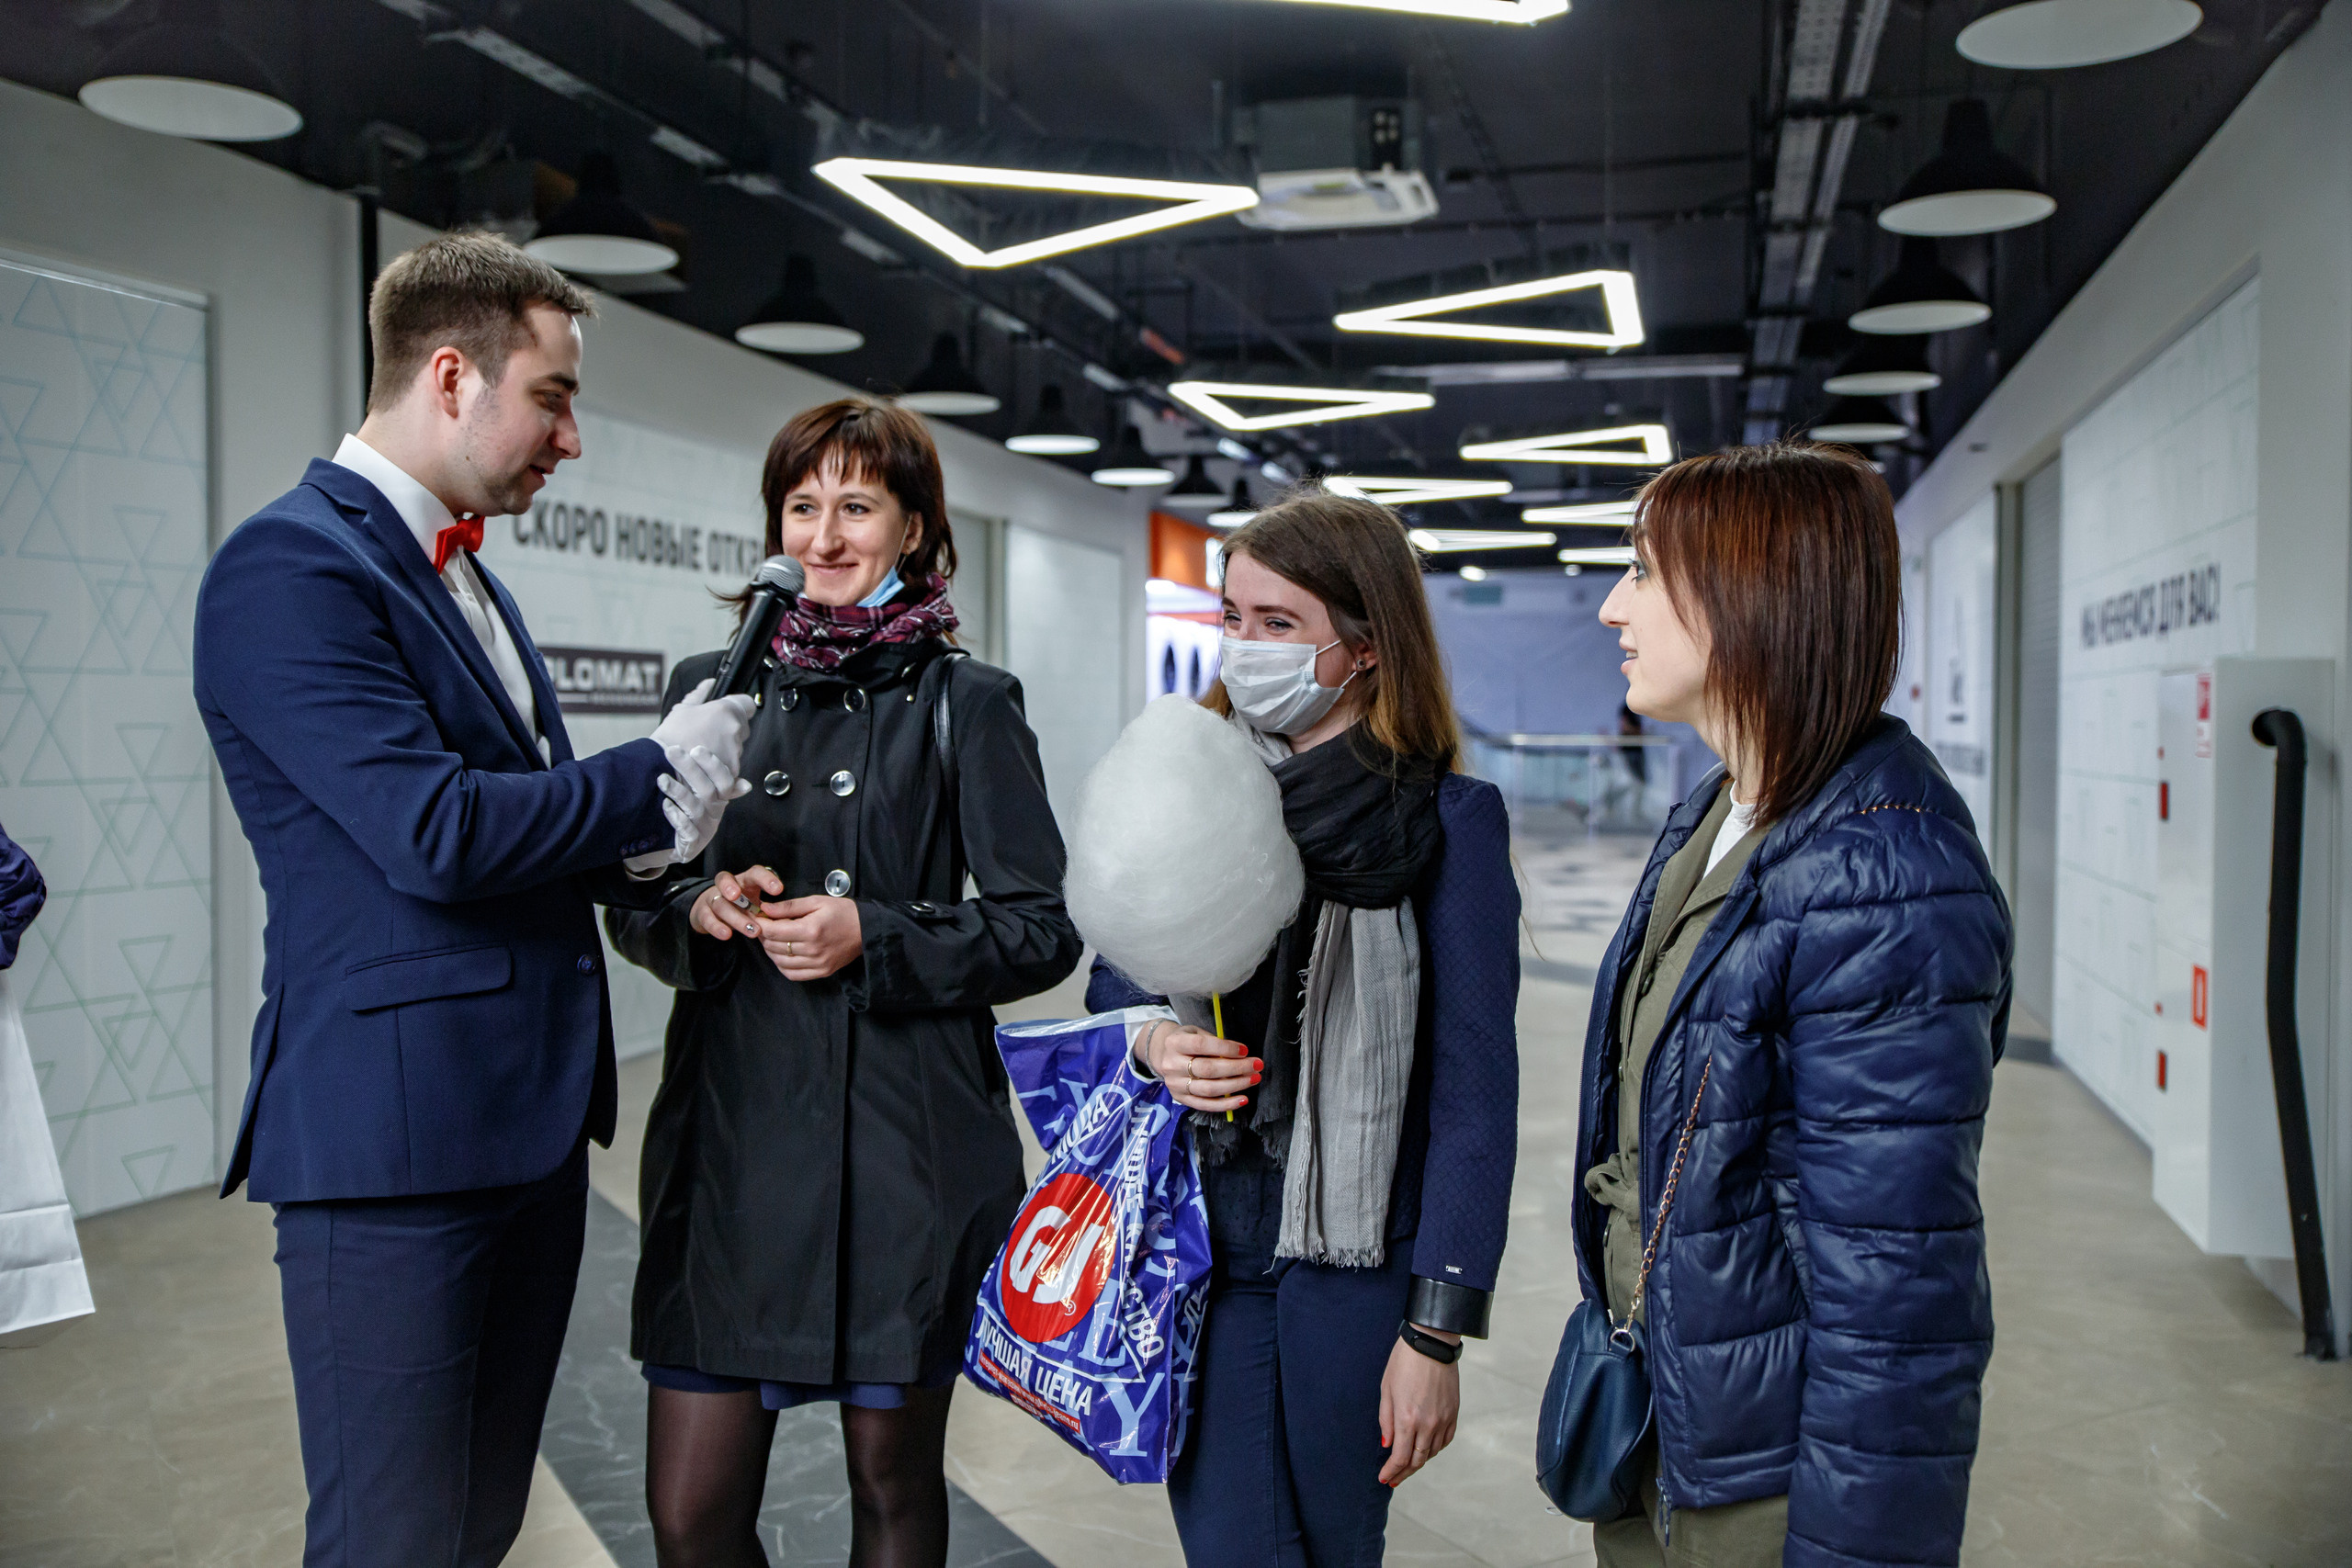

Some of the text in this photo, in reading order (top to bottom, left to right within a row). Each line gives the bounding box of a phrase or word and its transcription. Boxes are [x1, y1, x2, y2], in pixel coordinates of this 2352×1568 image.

[513, 500, 766, 578] СКОРО НОВЫЕ ОТКР
[1009, 1205, 1106, 1304] GJ
[975, 1314, 1033, 1385] ЛУЧШАЯ
[1035, 1366, 1093, 1416] ЦЕНА
